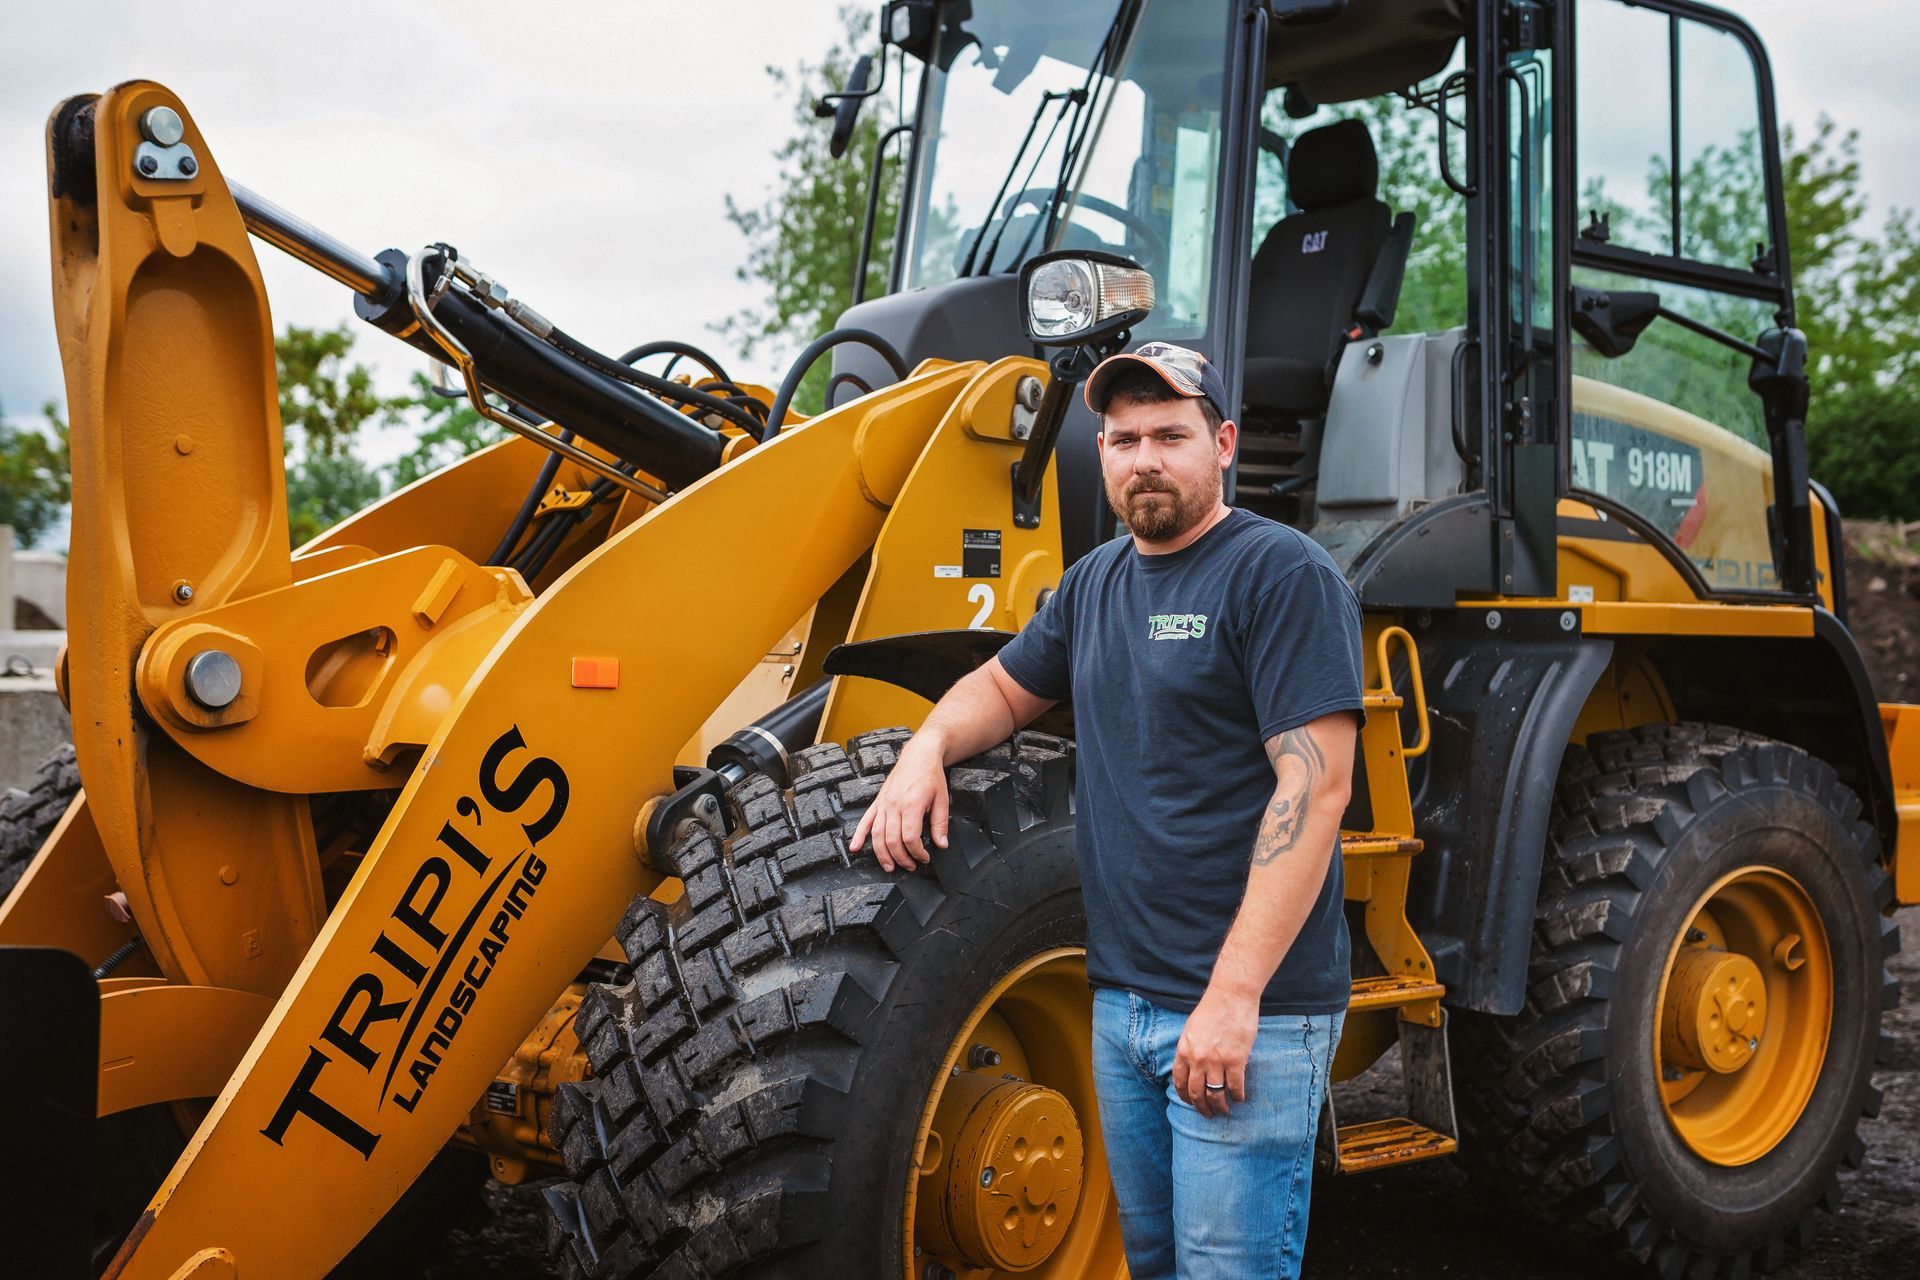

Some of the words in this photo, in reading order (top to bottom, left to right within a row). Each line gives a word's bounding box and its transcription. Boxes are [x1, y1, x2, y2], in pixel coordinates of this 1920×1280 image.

[1302, 230, 1329, 254] CAT
[1136, 345, 1172, 357] AT
[1572, 438, 1614, 496] AT
[1627, 448, 1692, 493] 918M
[967, 583, 996, 630] 2
[259, 723, 571, 1162] TRIPI'S
[392, 852, 548, 1114] LANDSCAPING
